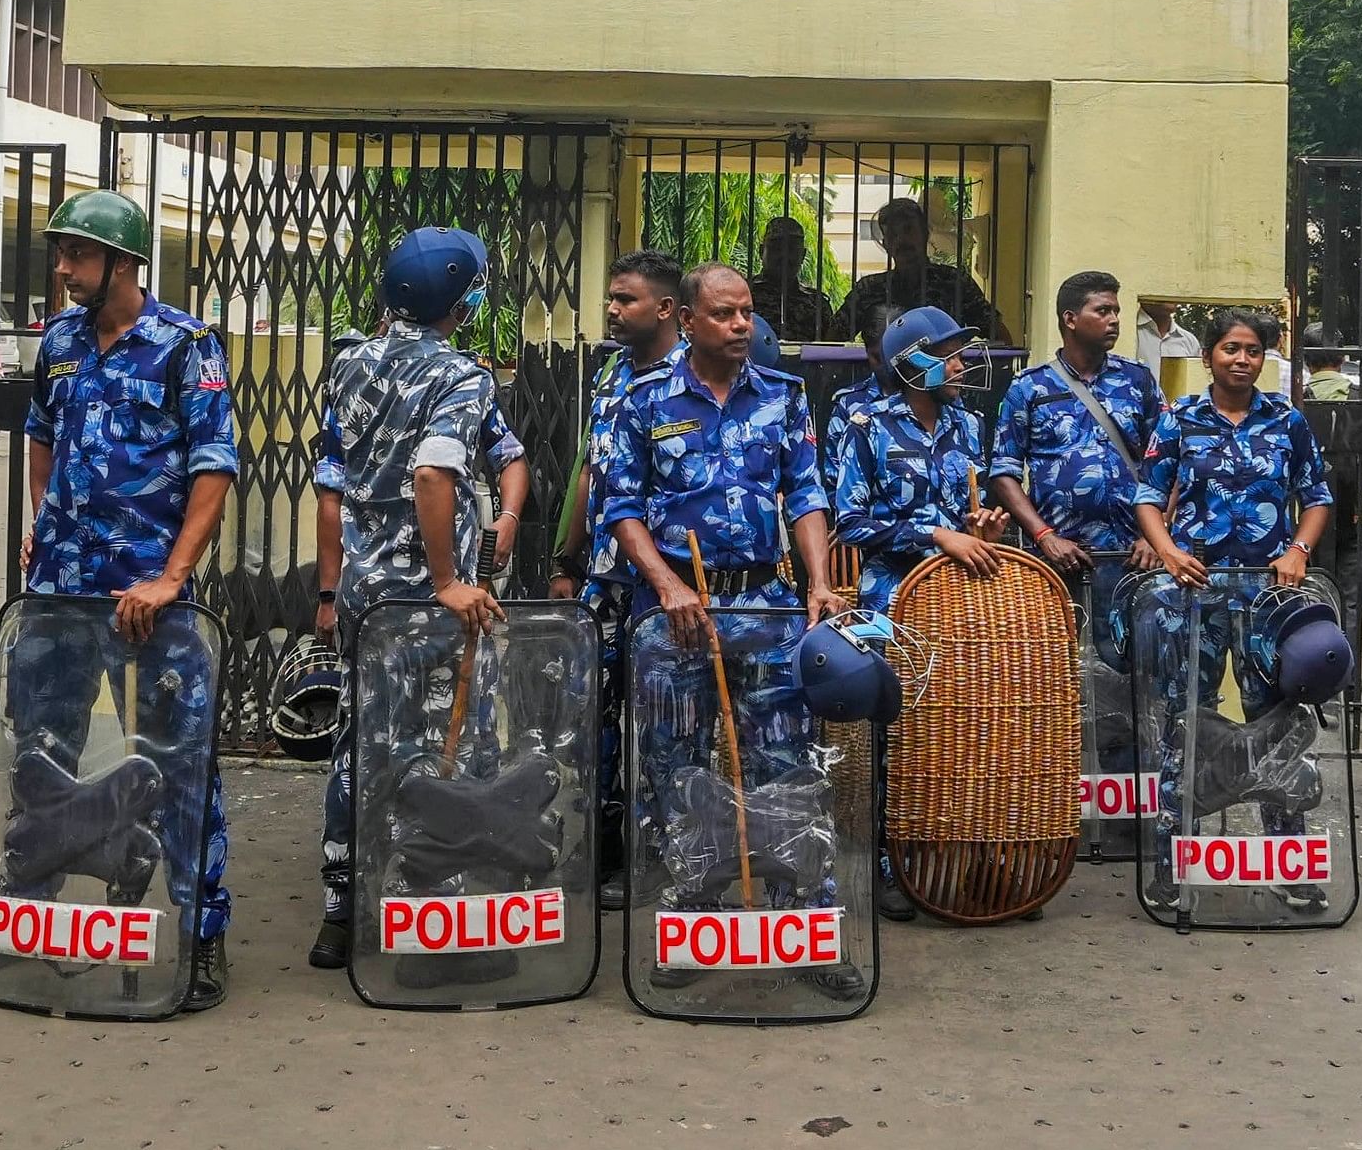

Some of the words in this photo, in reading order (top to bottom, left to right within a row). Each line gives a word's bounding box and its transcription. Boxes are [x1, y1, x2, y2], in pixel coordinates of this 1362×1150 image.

[1175, 838, 1329, 882] POLICE
[383, 892, 562, 951] POLICE
[658, 912, 839, 966] POLICE
